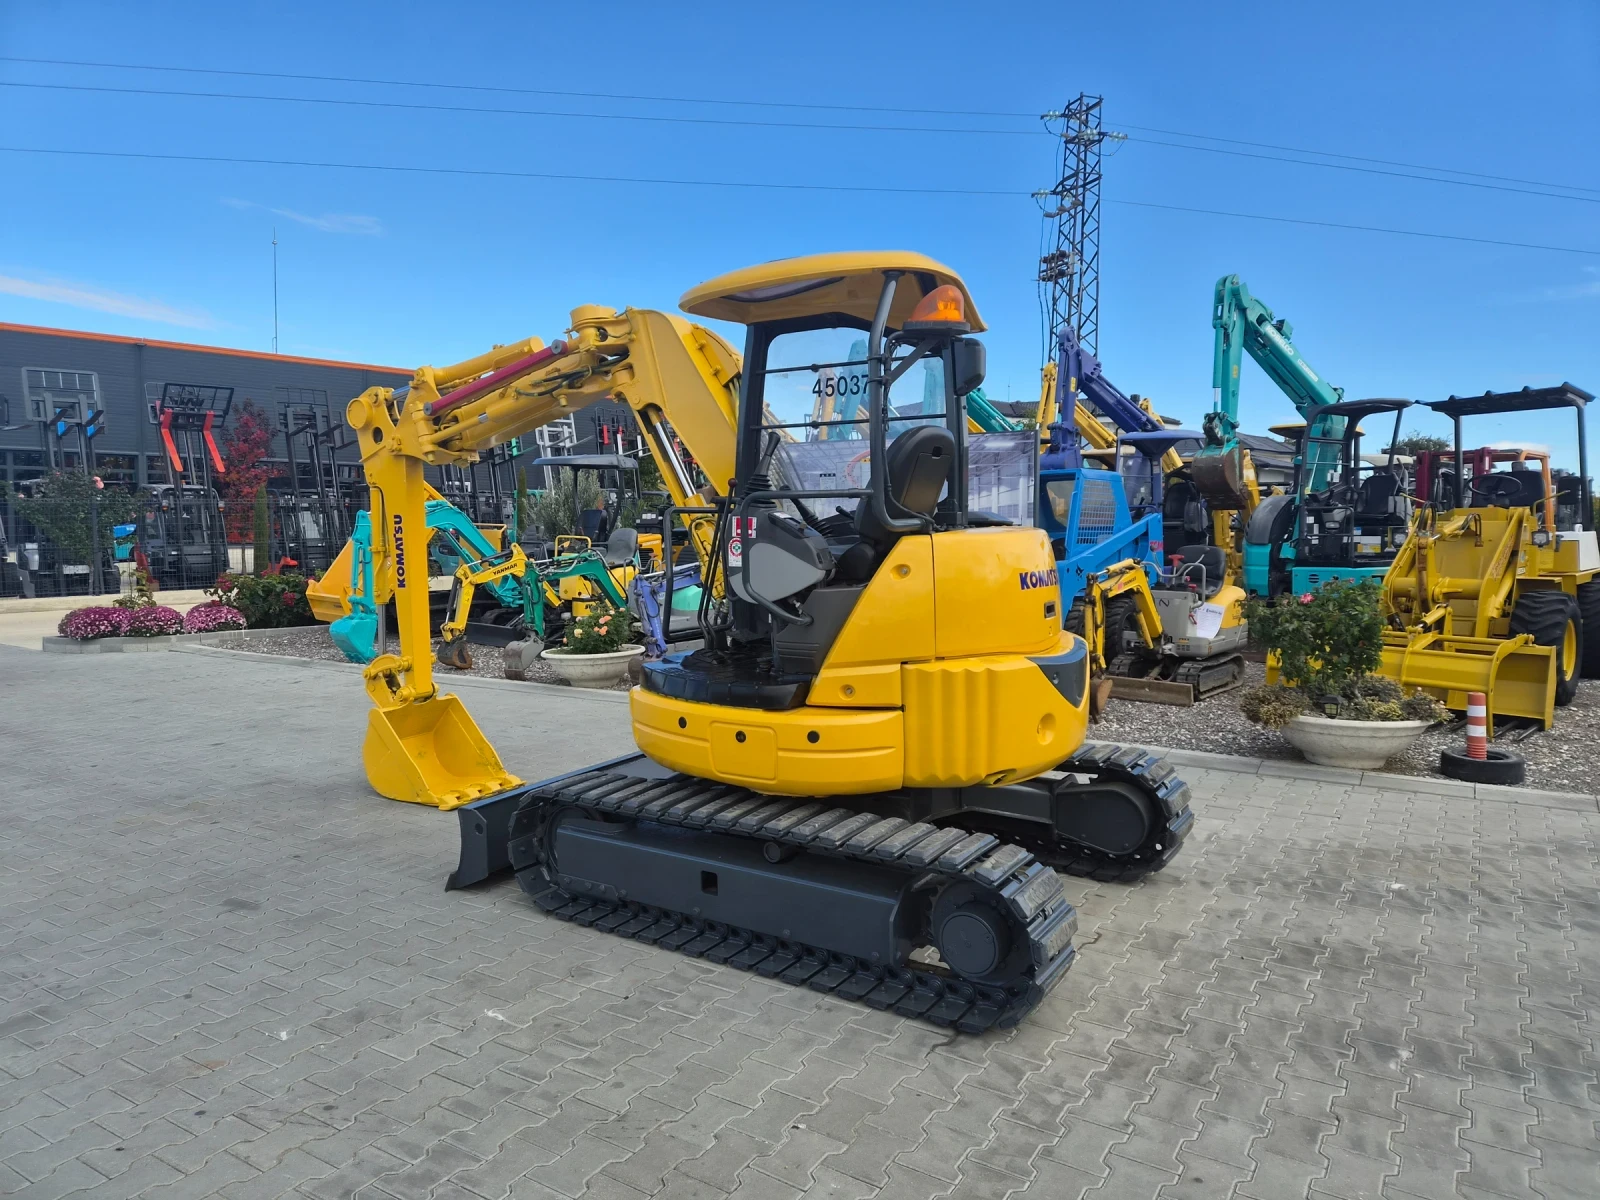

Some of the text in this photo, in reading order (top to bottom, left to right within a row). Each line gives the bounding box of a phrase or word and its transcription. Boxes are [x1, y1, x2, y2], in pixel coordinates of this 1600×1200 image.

[812, 374, 868, 397] 45037
[393, 514, 406, 588] KOMATSU
[493, 562, 518, 575] YANMAR
[1019, 569, 1059, 590] KOMATS
